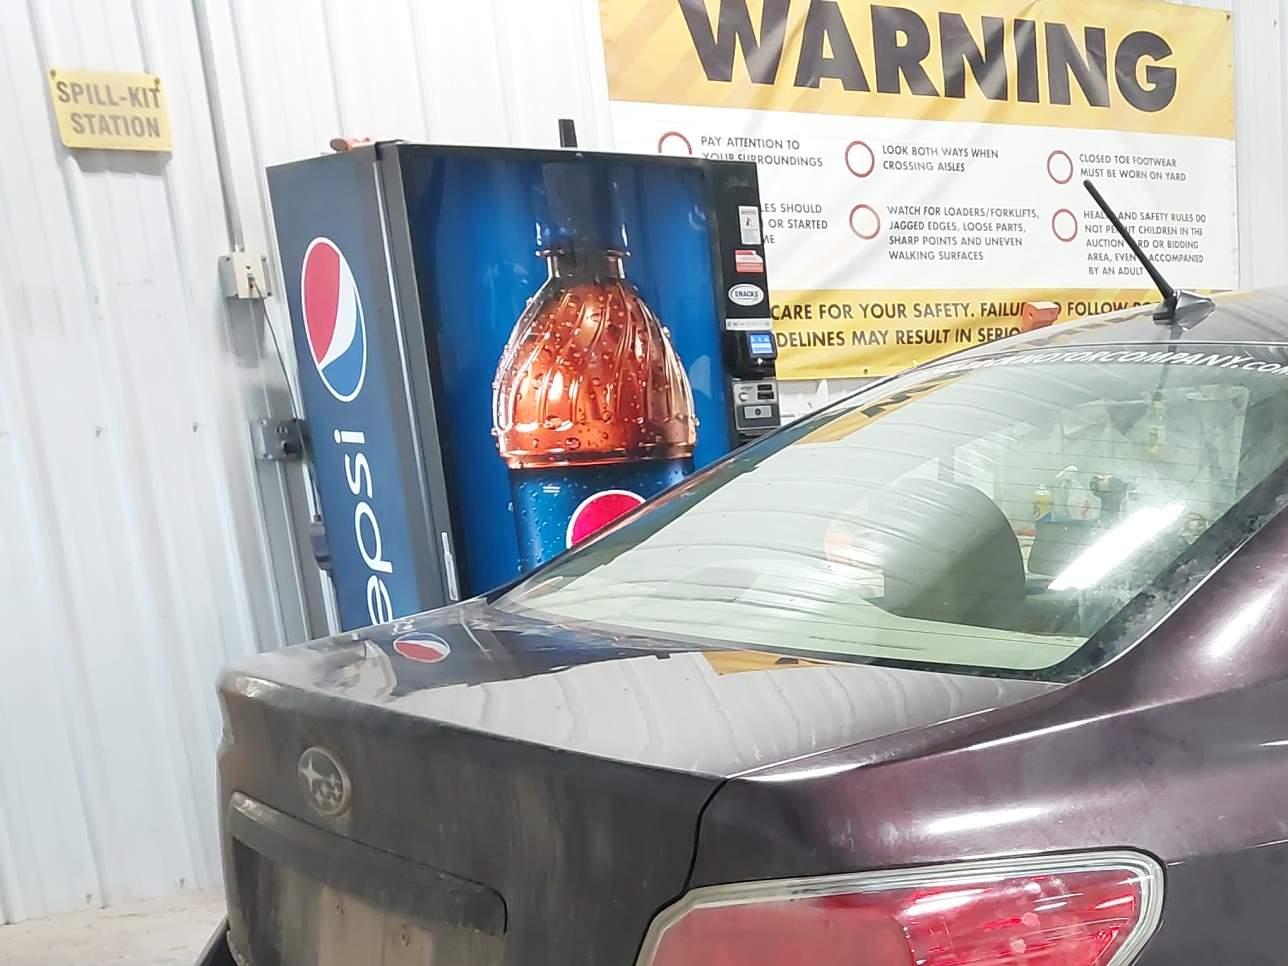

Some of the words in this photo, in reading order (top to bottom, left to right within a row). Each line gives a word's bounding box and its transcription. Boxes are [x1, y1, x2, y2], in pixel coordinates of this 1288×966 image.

[677, 0, 1178, 112] WARNING
[56, 81, 160, 108] SPILL-KIT
[70, 112, 160, 138] STATION
[701, 136, 721, 147] PAY
[727, 137, 783, 149] ATTENTION
[787, 140, 800, 150] TO
[882, 145, 909, 155] LOOK
[912, 147, 938, 156] BOTH
[941, 148, 969, 157] WAYS
[971, 149, 999, 158] WHEN
[738, 153, 823, 167] SURROUNDINGS
[883, 160, 934, 171] CROSSING
[938, 162, 966, 172] AISLES
[1079, 153, 1112, 164] CLOSED
[1114, 156, 1130, 165] TOE
[1133, 157, 1177, 167] FOOTWEAR
[1080, 168, 1104, 178] MUST
[1107, 169, 1117, 178] BE
[1120, 170, 1147, 179] WORN
[1150, 171, 1163, 180] ON
[1166, 172, 1186, 181] YARD
[781, 204, 822, 214] SHOULD
[887, 206, 921, 216] WATCH
[924, 206, 941, 216] FOR
[944, 207, 1040, 219] LOADERS/FORKLIFTS,
[1118, 211, 1138, 221] AND
[1140, 212, 1168, 221] SAFETY
[1171, 213, 1194, 223] RULES
[1195, 214, 1207, 223] DO
[768, 219, 784, 229] OR
[788, 219, 828, 229] STARTED
[889, 221, 925, 231] JAGGED
[928, 222, 960, 232] EDGES,
[963, 222, 993, 232] LOOSE
[996, 223, 1026, 233] PARTS,
[1085, 224, 1103, 234] NOT
[1138, 226, 1178, 235] CHILDREN
[1180, 227, 1189, 236] IN
[1191, 227, 1203, 236] THE
[889, 236, 919, 246] SHARP
[923, 236, 958, 246] POINTS
[961, 237, 981, 246] AND
[985, 237, 1023, 247] UNEVEN
[1086, 239, 1125, 248] AUCTION
[1152, 240, 1165, 249] OR
[1167, 240, 1199, 249] BIDDING
[889, 251, 935, 260] WALKING
[938, 251, 984, 260] SURFACES
[1087, 253, 1112, 263] AREA,
[1115, 253, 1136, 262] EVEN
[1148, 254, 1204, 263] ACCOMPANIED
[1089, 267, 1099, 275] BY
[1102, 267, 1115, 275] AN
[1118, 267, 1143, 276] ADULT
[734, 290, 759, 298] SNACKS
[771, 304, 812, 320] CARE
[819, 304, 853, 320] FOR
[859, 303, 908, 319] YOUR
[913, 303, 975, 319] SAFETY.
[1068, 301, 1128, 316] FOLLOW
[777, 331, 845, 347] DELINES
[852, 330, 889, 346] MAY
[896, 329, 951, 345] RESULT
[955, 328, 972, 343] IN
